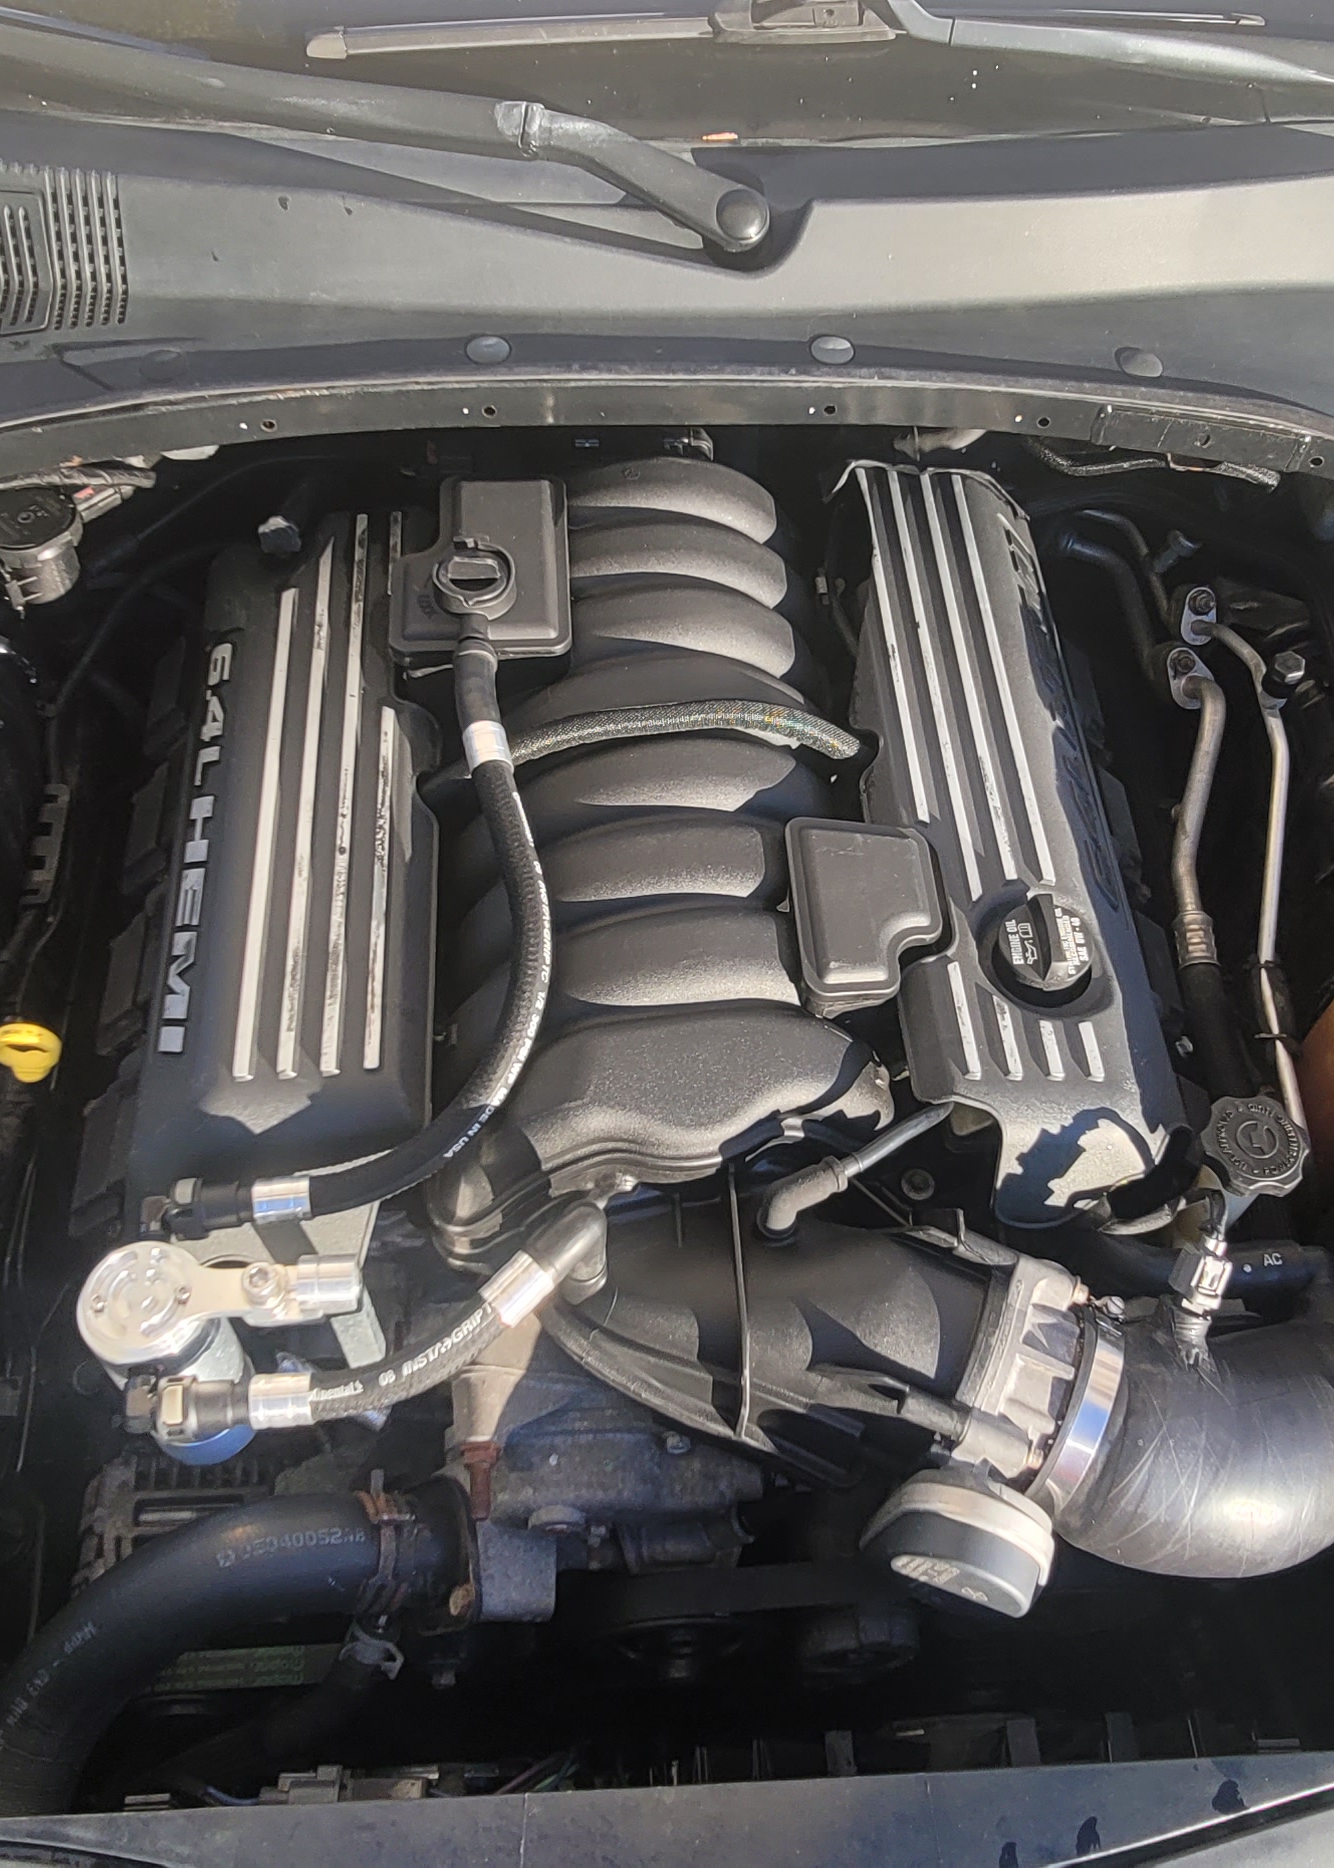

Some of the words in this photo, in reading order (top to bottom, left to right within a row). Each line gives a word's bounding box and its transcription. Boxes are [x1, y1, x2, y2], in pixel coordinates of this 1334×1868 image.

[157, 794, 215, 1054] HEMI
[1004, 919, 1017, 933] OIL
[1007, 933, 1025, 965] ENGINE
[1077, 946, 1089, 962] SAE
[478, 1089, 508, 1124] MADE
[466, 1121, 482, 1137] IN
[443, 1133, 470, 1160] USA
[1263, 1252, 1283, 1267] AC
